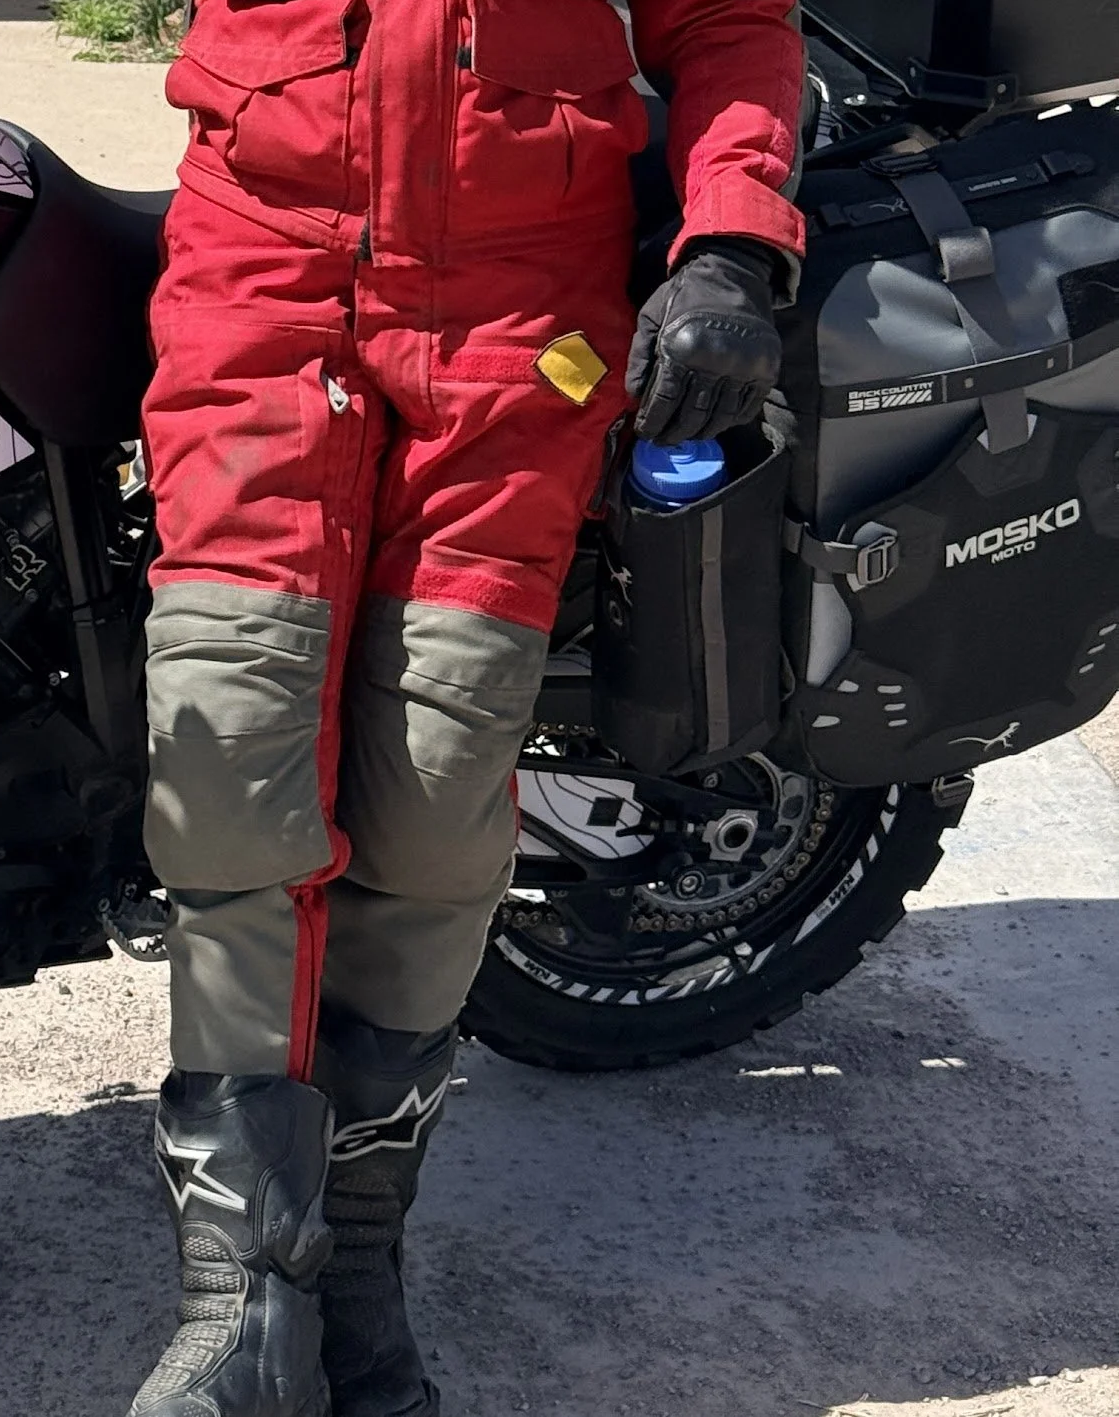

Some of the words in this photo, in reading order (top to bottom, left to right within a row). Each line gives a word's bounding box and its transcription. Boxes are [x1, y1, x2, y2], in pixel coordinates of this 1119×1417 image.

[848, 396, 881, 413] 35
[945, 498, 1081, 568] MOSKO
[991, 540, 1036, 564] MOTO
[828, 873, 855, 907] KTM
[523, 960, 551, 980] KTM
